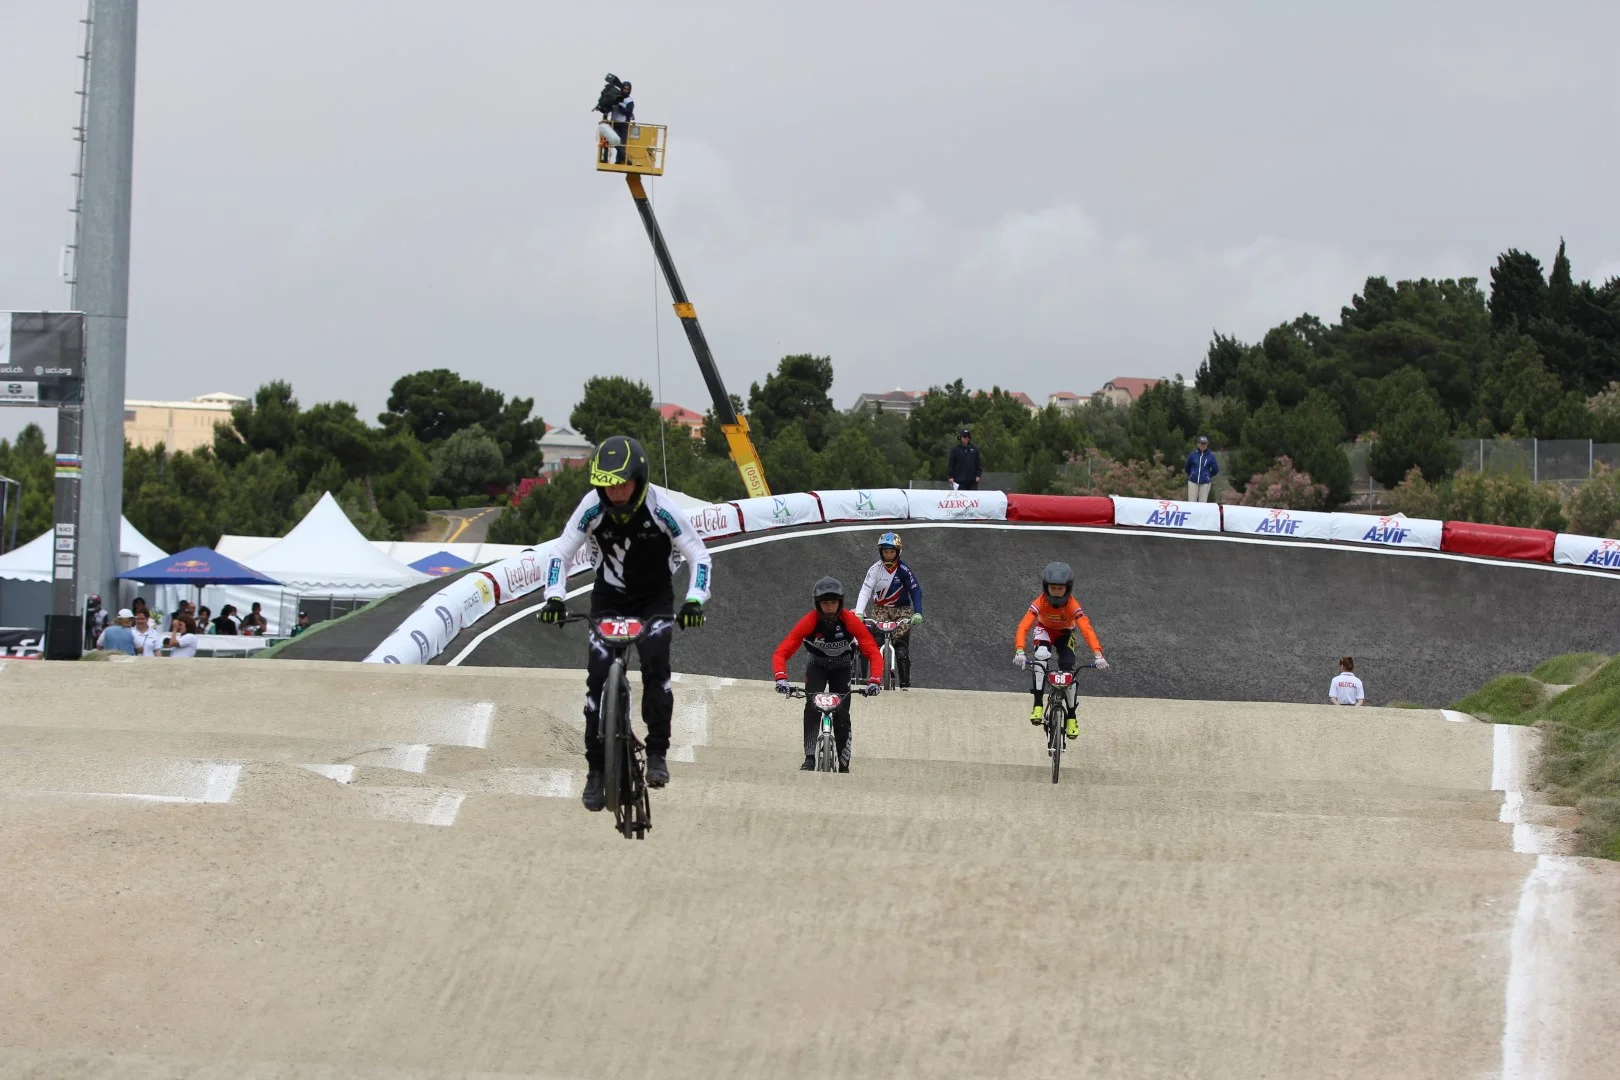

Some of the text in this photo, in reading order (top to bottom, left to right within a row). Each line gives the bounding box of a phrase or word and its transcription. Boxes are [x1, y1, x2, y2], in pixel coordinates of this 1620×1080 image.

[45, 367, 72, 376] uci.org
[611, 622, 630, 635] 73
[1054, 674, 1066, 684] 68
[821, 696, 833, 706] 63
